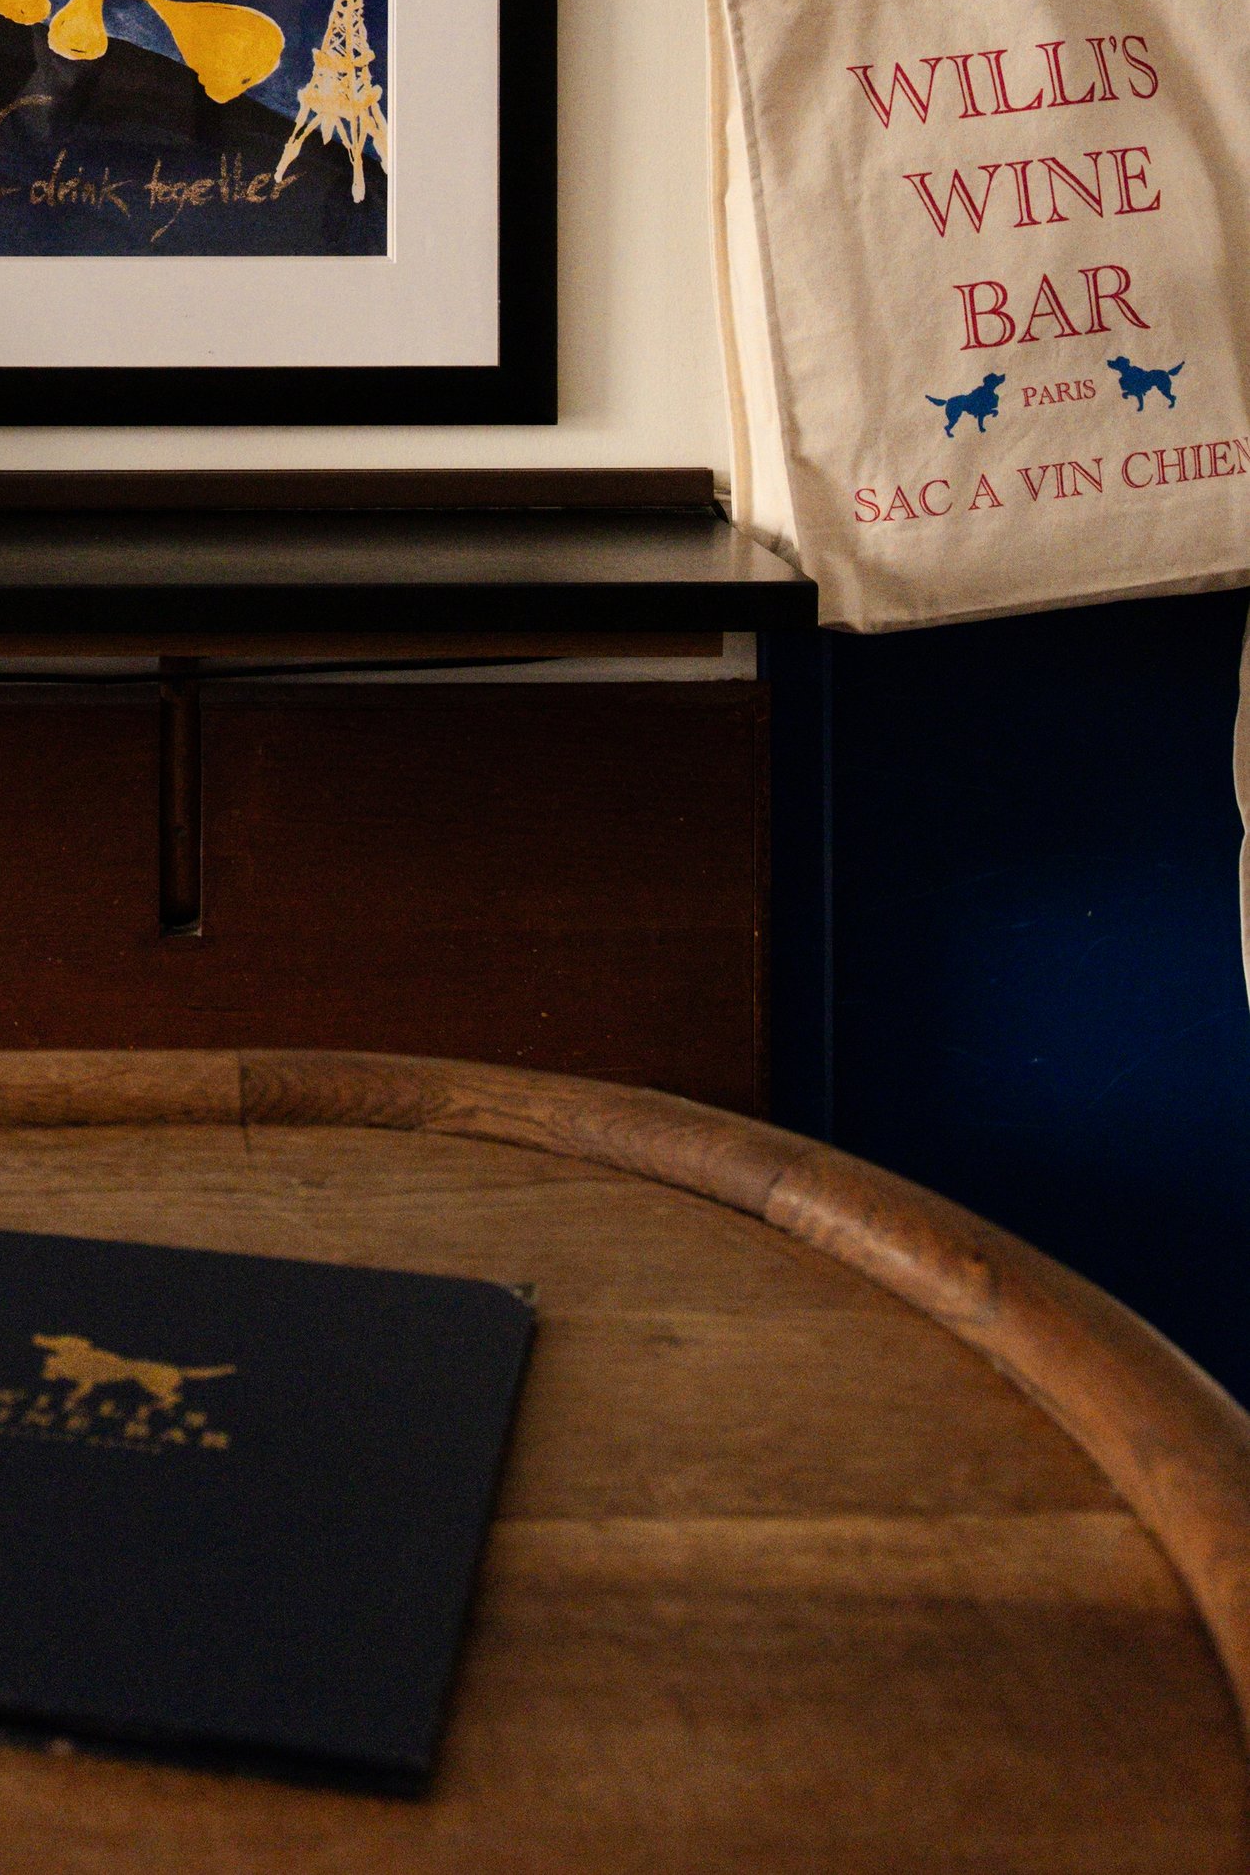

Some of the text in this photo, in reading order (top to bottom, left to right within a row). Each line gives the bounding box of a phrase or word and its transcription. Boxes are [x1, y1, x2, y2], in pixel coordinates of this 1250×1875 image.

[846, 34, 1159, 129] WILLI'S
[29, 148, 133, 219] drink
[903, 146, 1162, 238] WINE
[953, 264, 1151, 351] BAR
[1021, 379, 1097, 408] PARIS
[853, 479, 954, 524] SAC
[968, 473, 1004, 511] A
[1017, 457, 1104, 502] VIN
